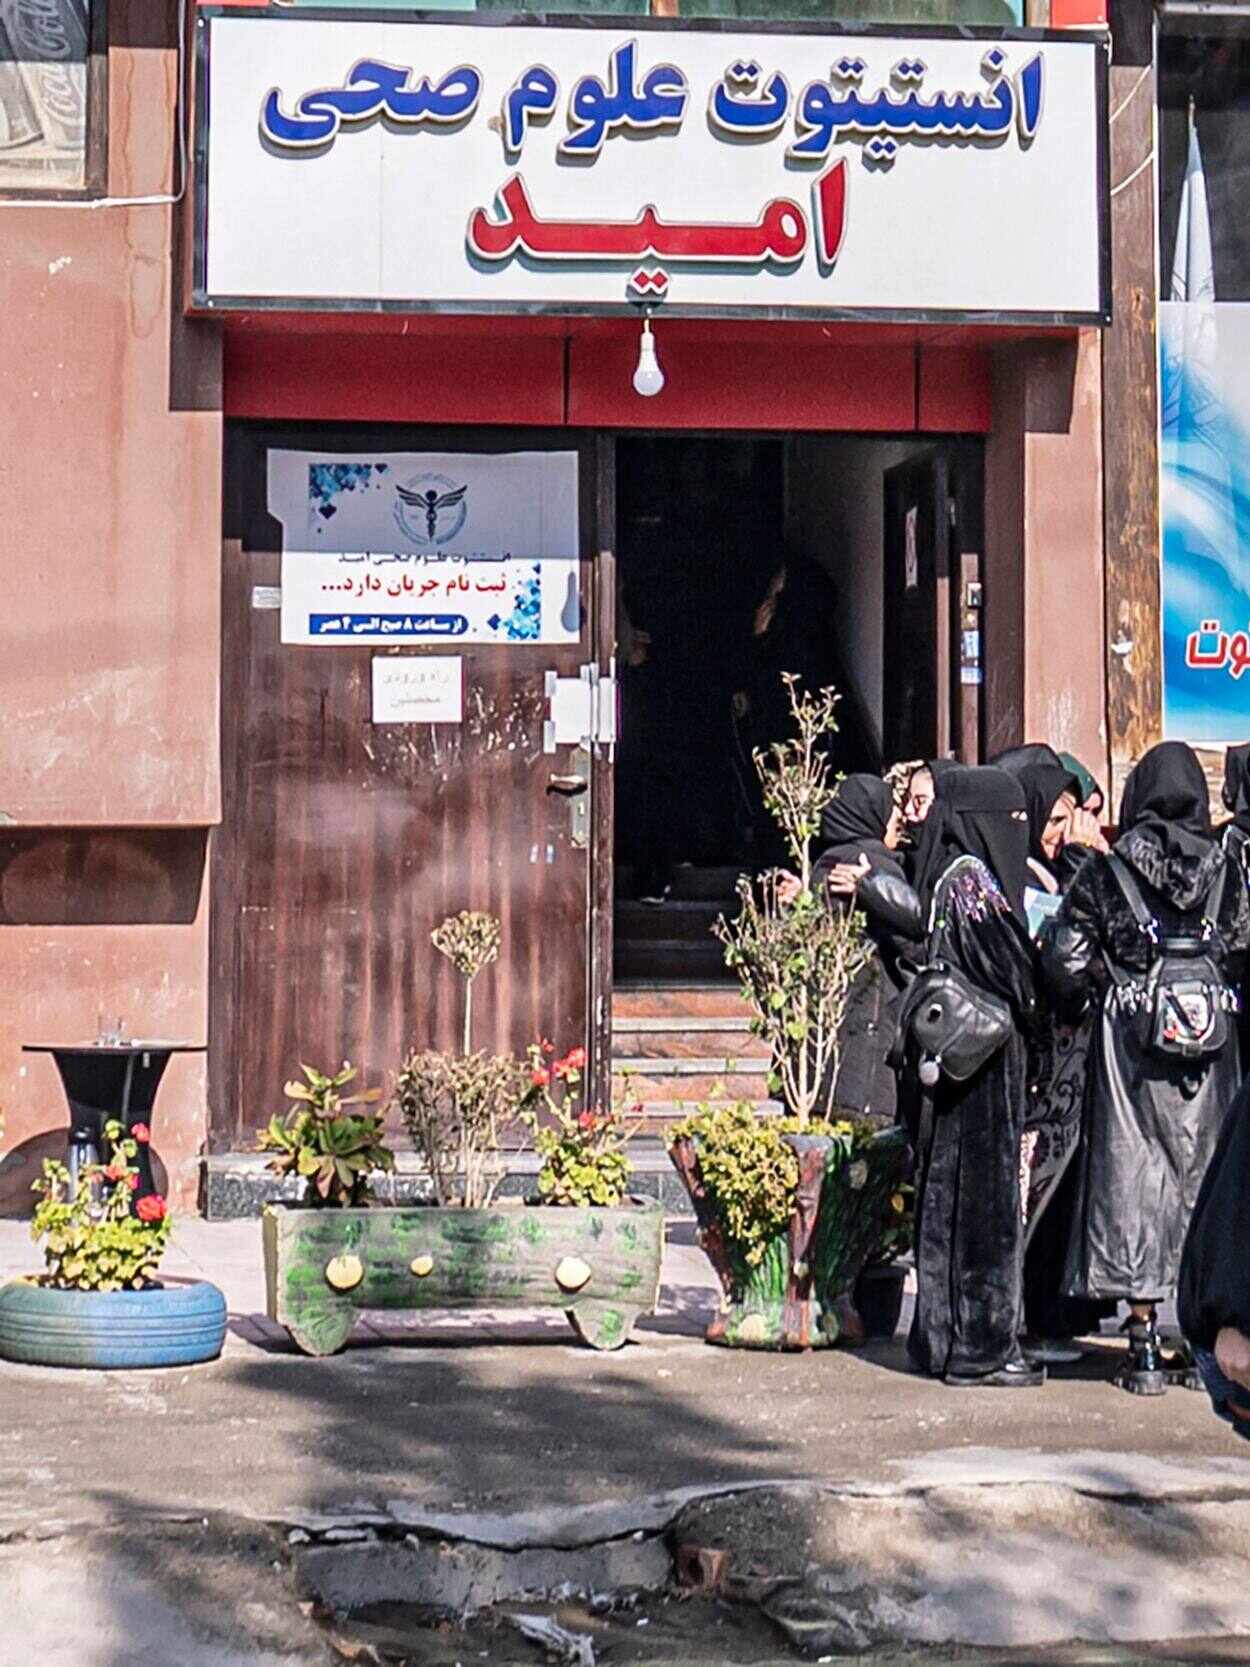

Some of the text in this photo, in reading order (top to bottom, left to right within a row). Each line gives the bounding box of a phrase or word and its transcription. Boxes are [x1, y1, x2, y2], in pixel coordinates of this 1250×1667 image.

[263, 39, 1043, 158] انستیتوت علوم صحی
[468, 160, 848, 292] امید
[387, 574, 440, 597] جریان
[446, 574, 470, 596] نام
